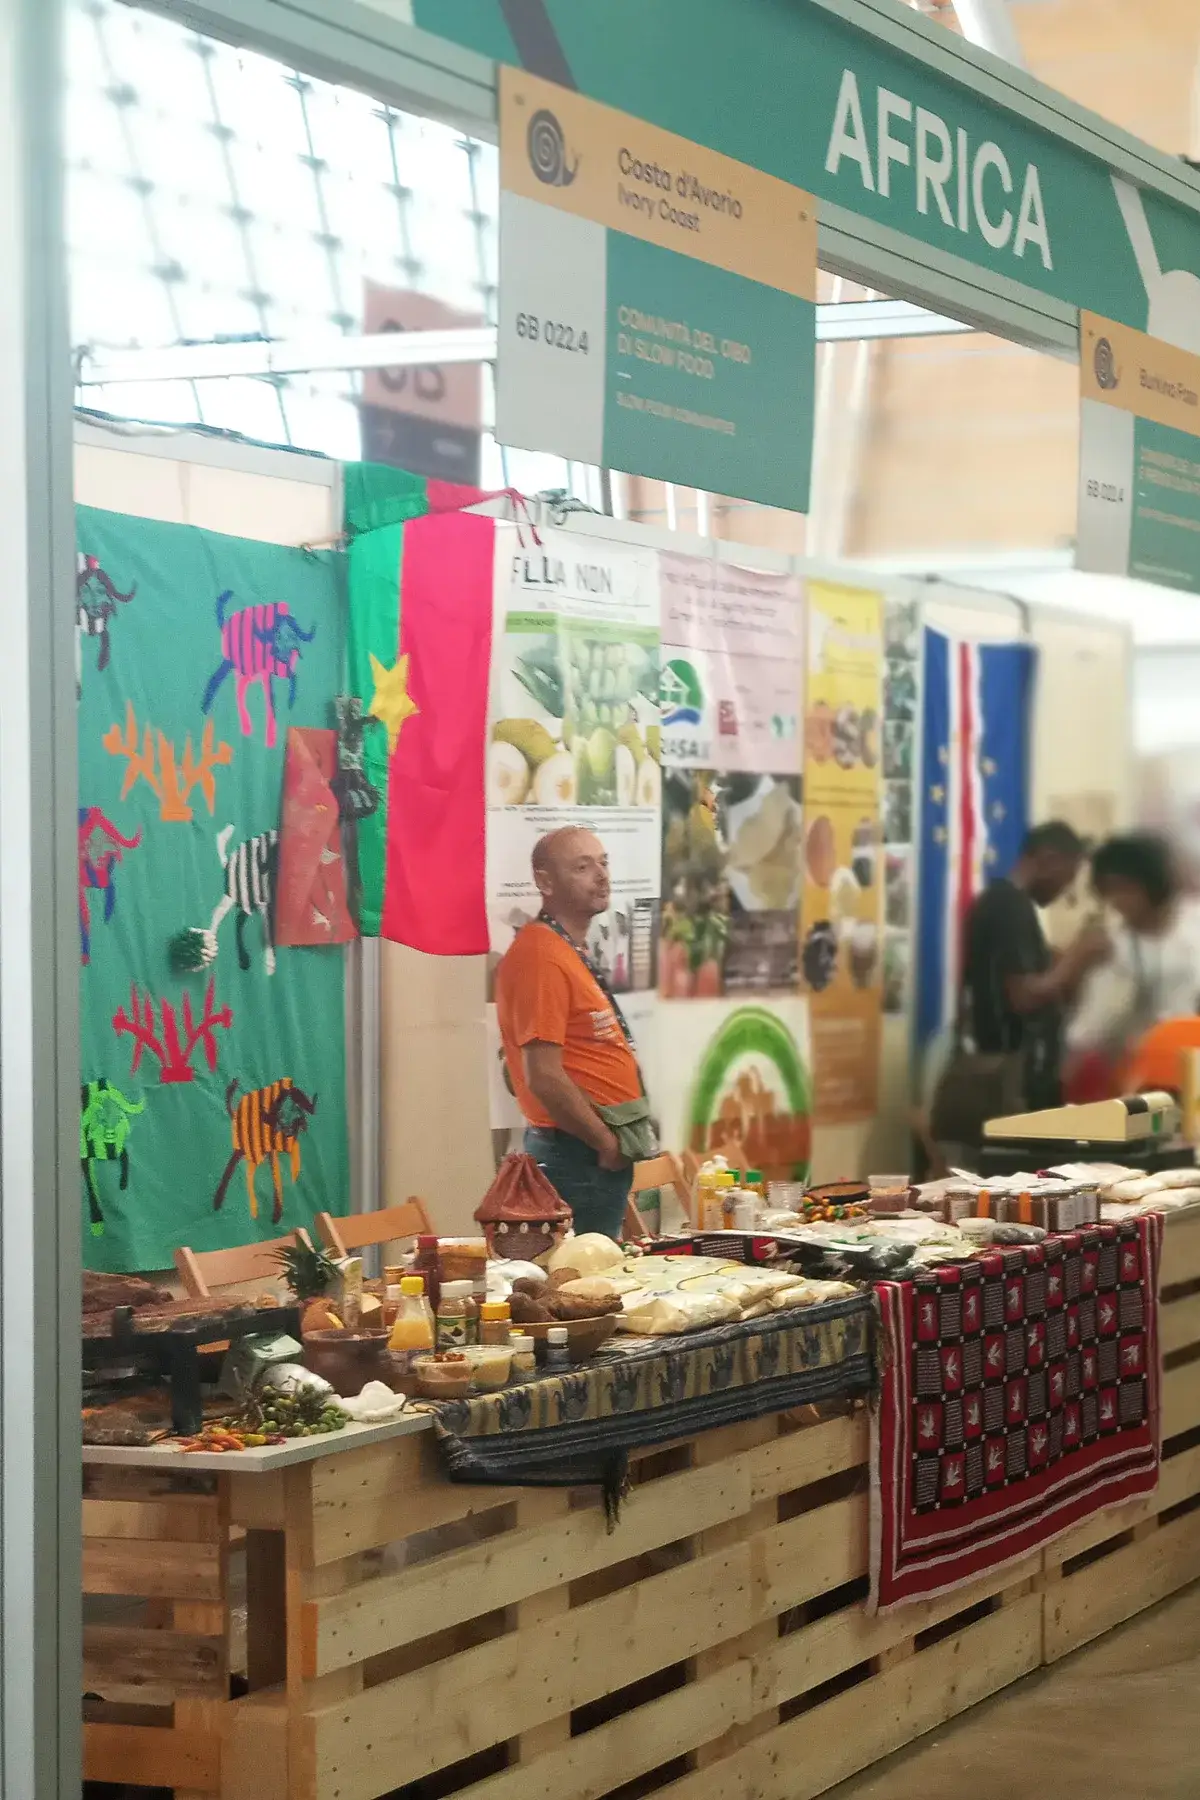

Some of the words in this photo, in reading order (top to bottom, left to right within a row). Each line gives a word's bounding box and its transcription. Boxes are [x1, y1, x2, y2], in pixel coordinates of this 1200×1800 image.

[618, 147, 671, 192] Costa
[676, 169, 743, 219] d'Avorio
[824, 68, 1053, 271] AFRICA
[618, 181, 655, 219] Ivory
[659, 198, 701, 233] Coast
[516, 312, 539, 341] 6B
[544, 320, 589, 355] 022.4
